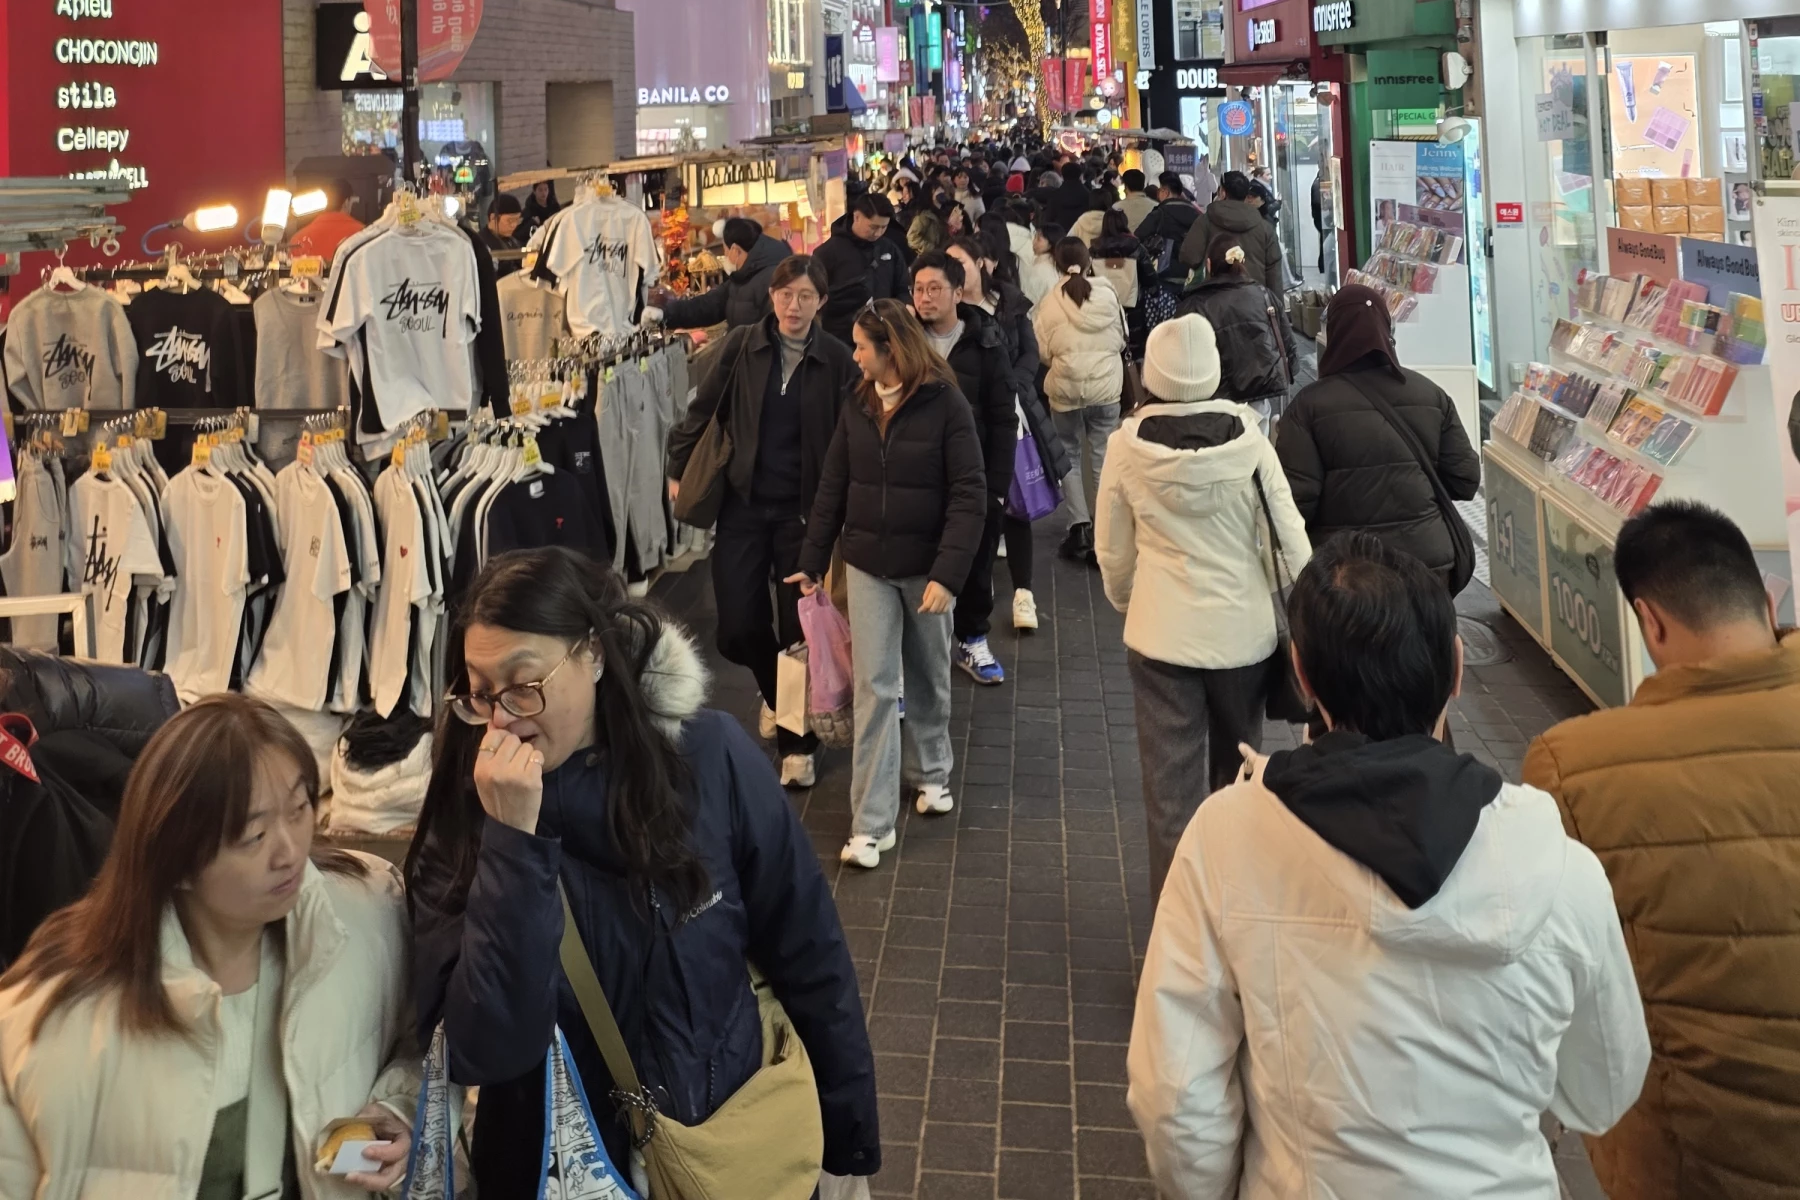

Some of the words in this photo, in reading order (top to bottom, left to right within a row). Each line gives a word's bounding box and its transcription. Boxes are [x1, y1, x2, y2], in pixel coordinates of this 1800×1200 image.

[1141, 13, 1152, 58] LOVERS
[56, 38, 158, 67] CHOGONGJIN
[1176, 67, 1227, 90] DOUB
[58, 81, 116, 109] stila
[638, 87, 701, 104] BANILA
[704, 85, 730, 101] CO
[1393, 112, 1427, 121] SPECIAL
[1552, 572, 1601, 655] 1000
